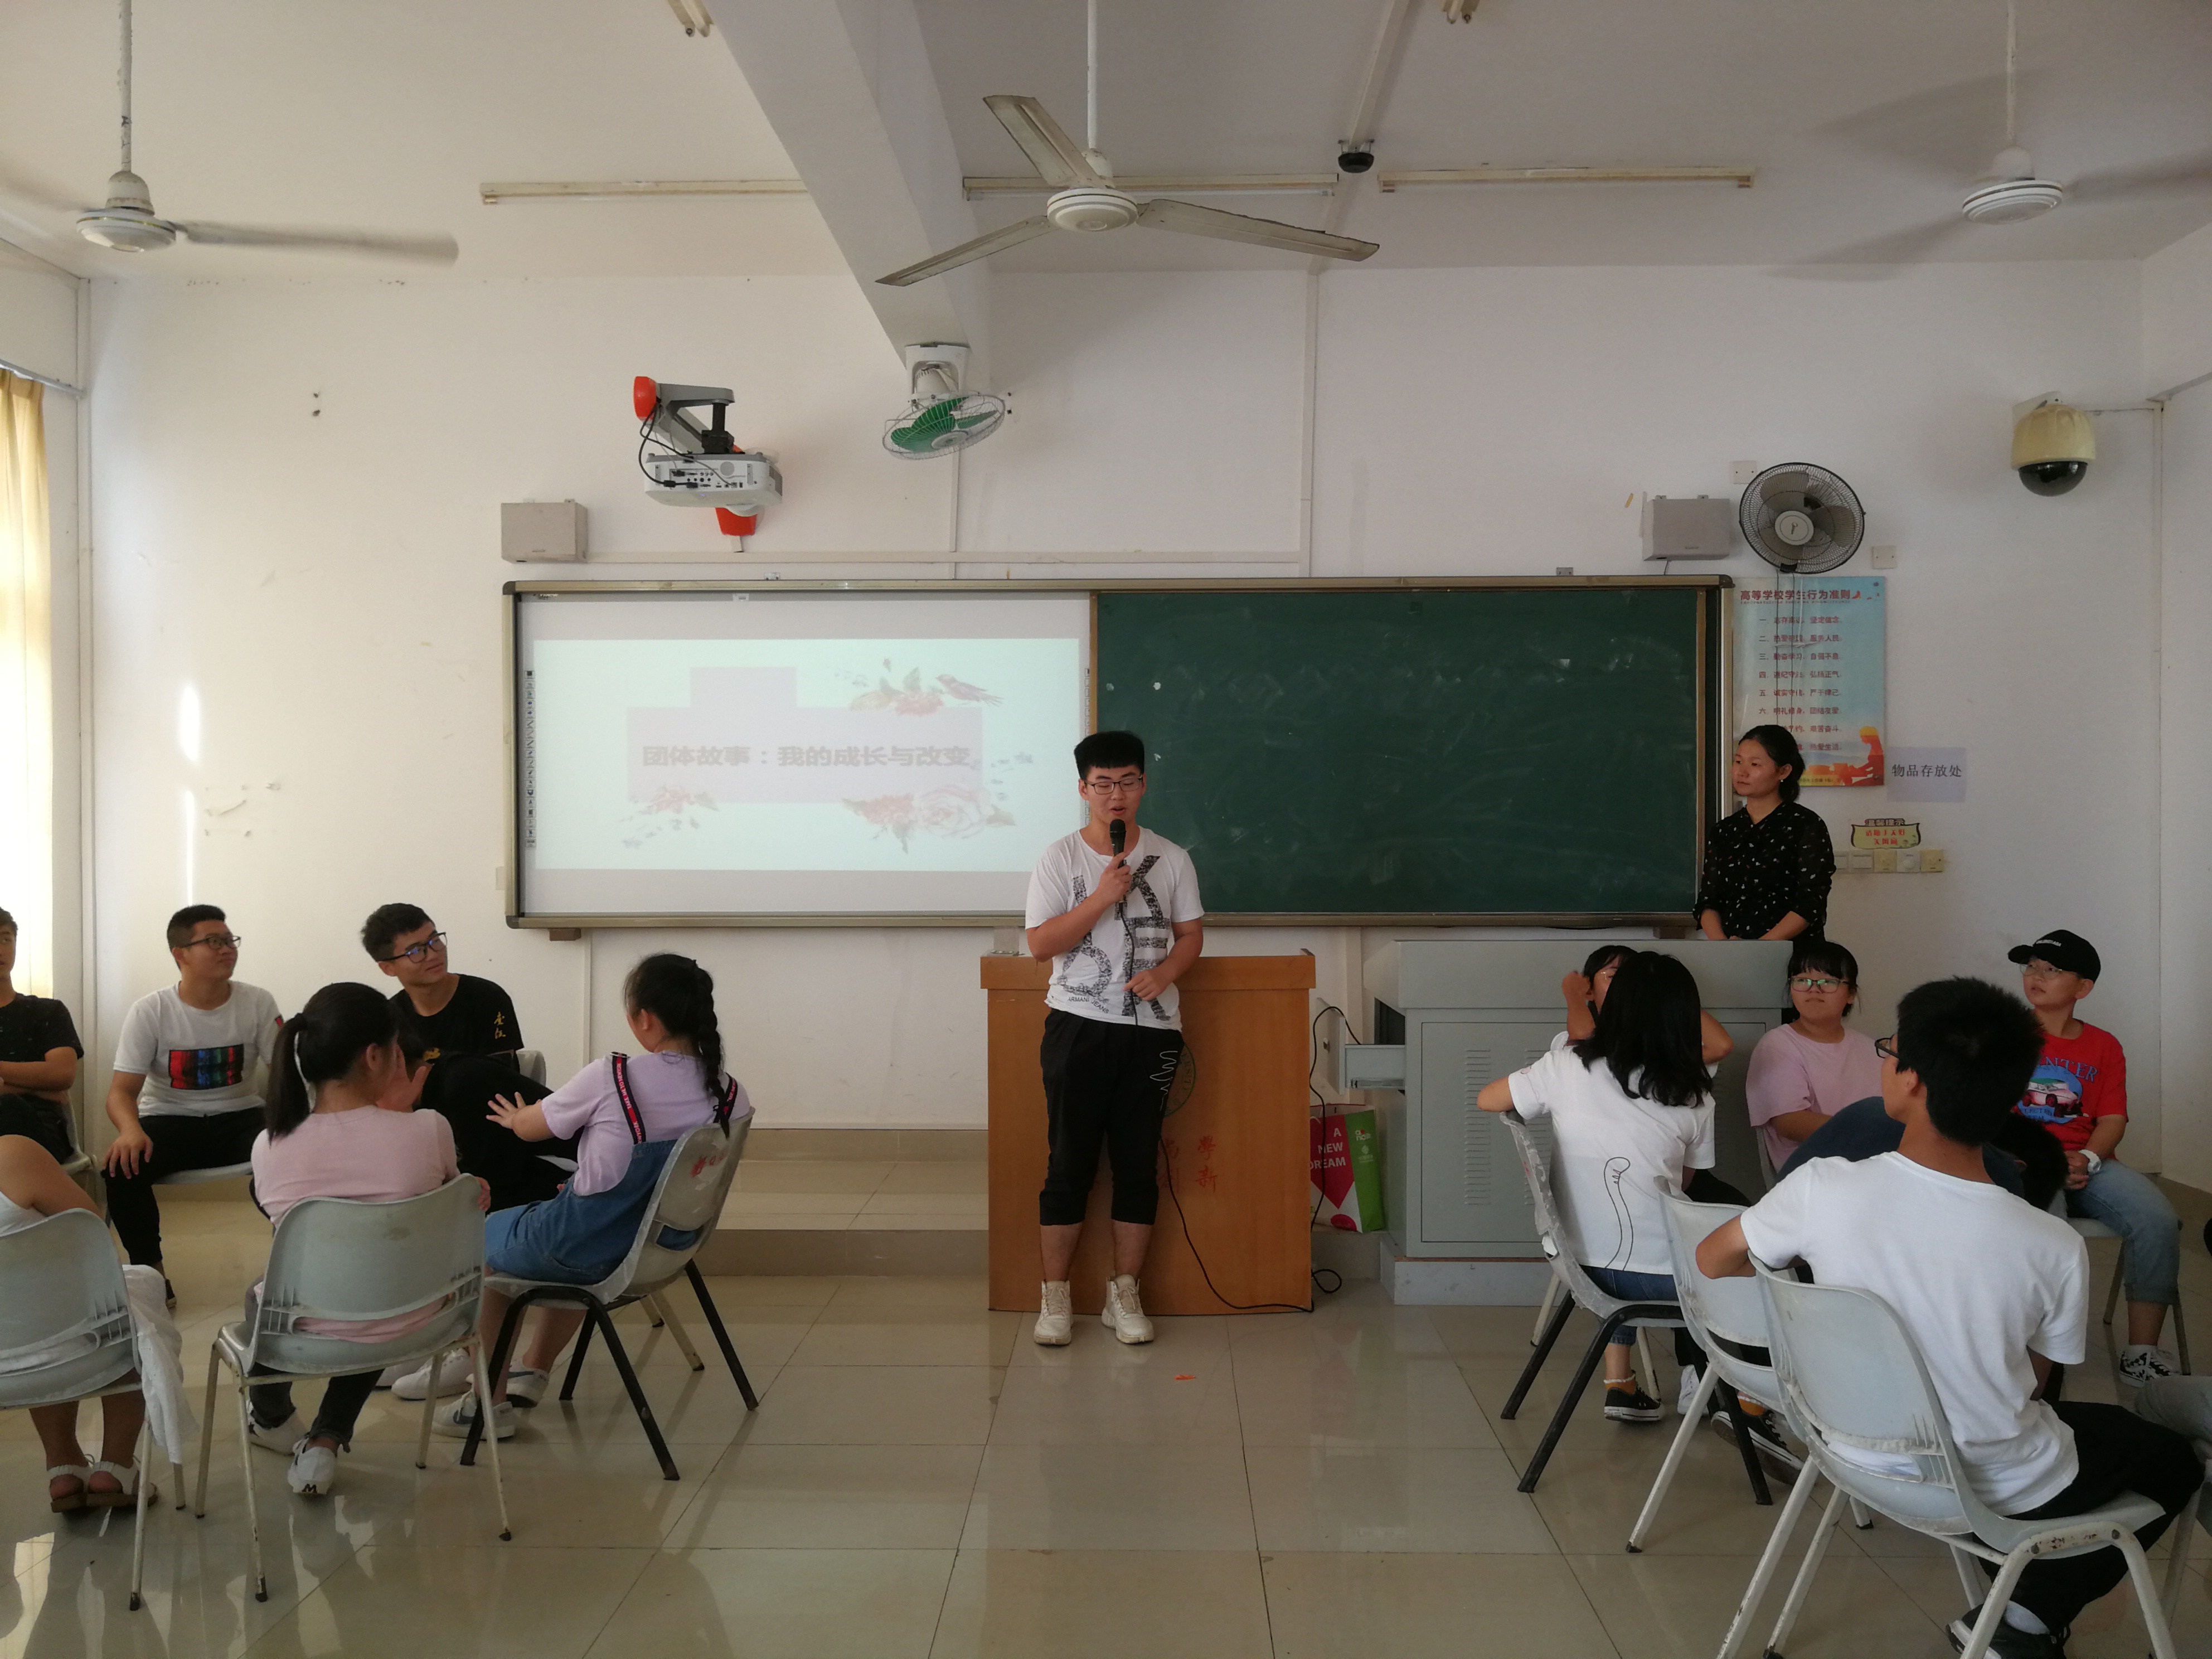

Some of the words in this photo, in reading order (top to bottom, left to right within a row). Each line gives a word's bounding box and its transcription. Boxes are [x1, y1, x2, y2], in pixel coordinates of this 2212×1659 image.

[1740, 590, 1850, 600] 高等学校学生行为准则
[642, 745, 971, 768] 团体故事：我的成长与改变
[1891, 764, 1962, 778] 物品存放处
[1091, 1000, 1109, 1013] JEANS
[2045, 1056, 2098, 1082] NTER
[1333, 1128, 1342, 1137] A
[1317, 1142, 1343, 1154] NEW
